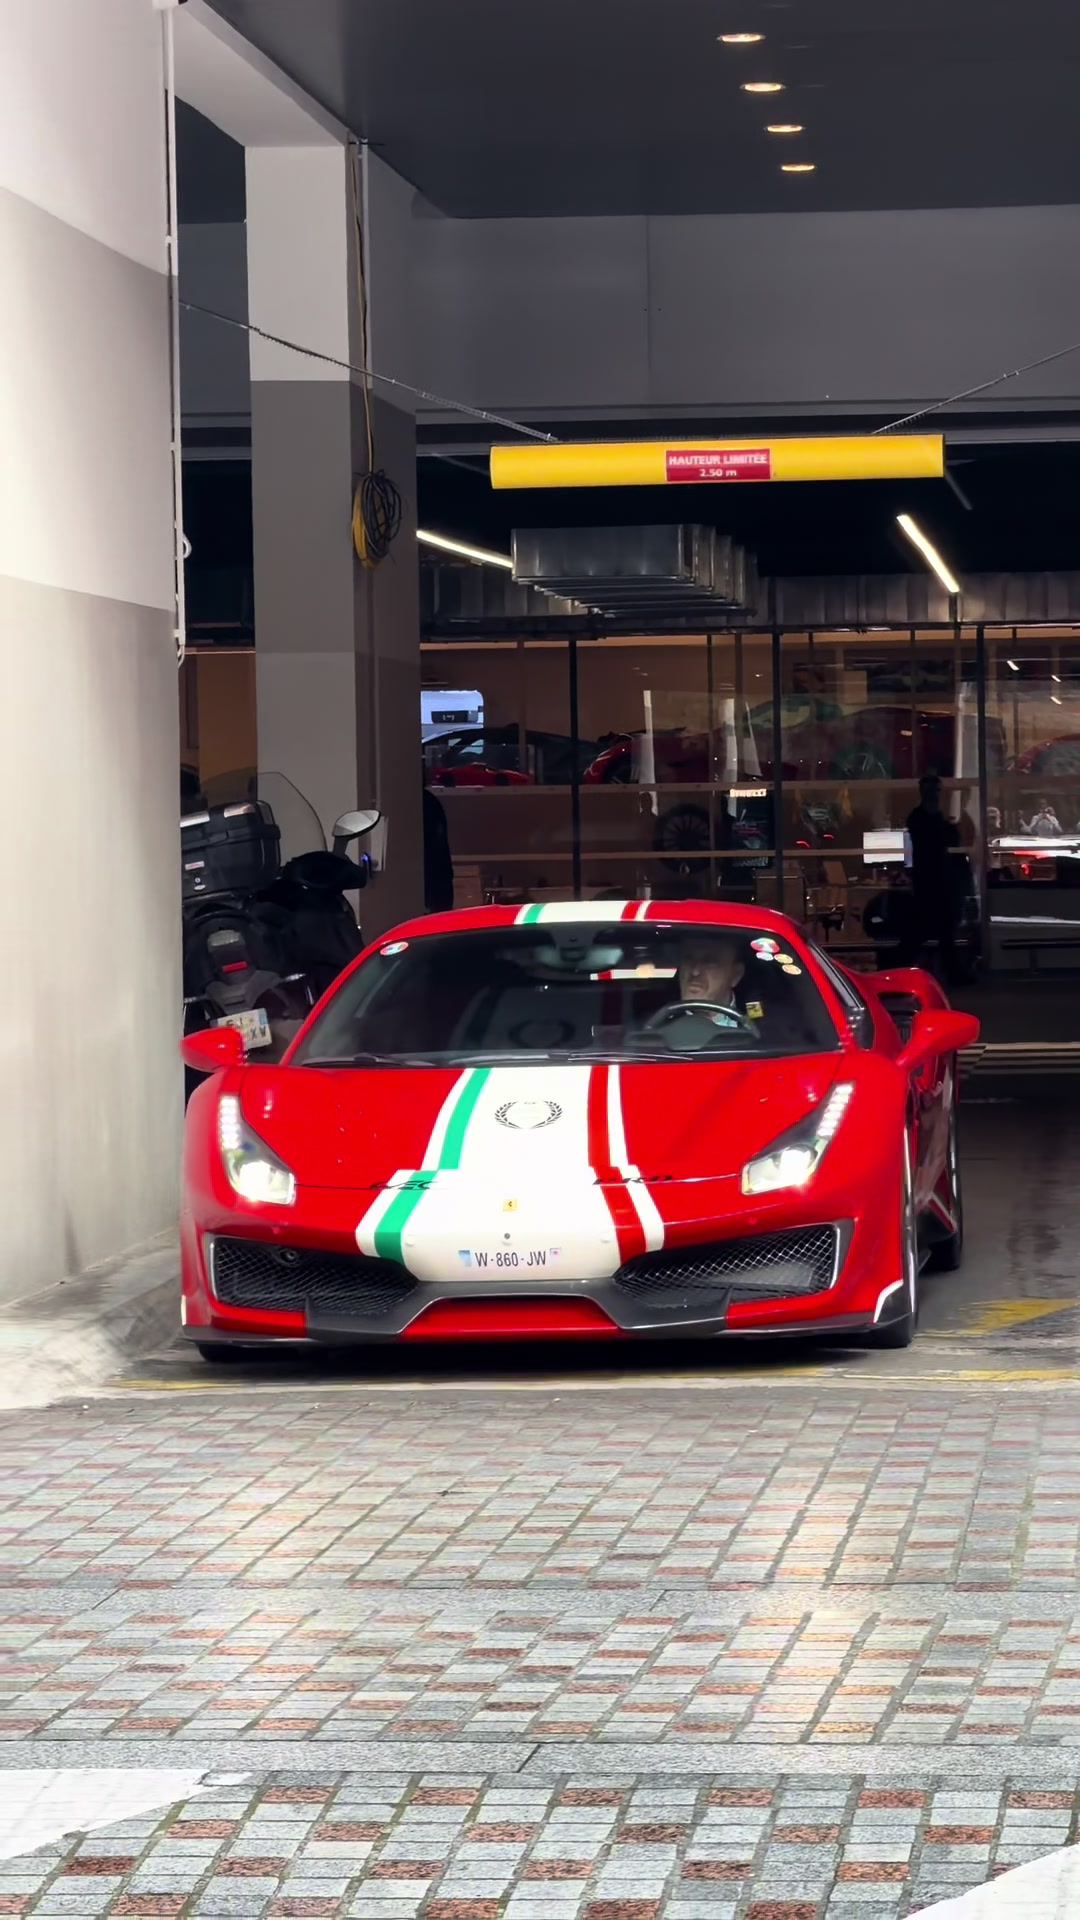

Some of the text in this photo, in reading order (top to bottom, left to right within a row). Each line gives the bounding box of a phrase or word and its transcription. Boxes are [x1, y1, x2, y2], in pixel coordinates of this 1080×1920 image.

[669, 453, 768, 466] HAUTEUR LIMITÉE
[699, 468, 737, 478] 2.50 m
[475, 1250, 546, 1268] W-860-JW
